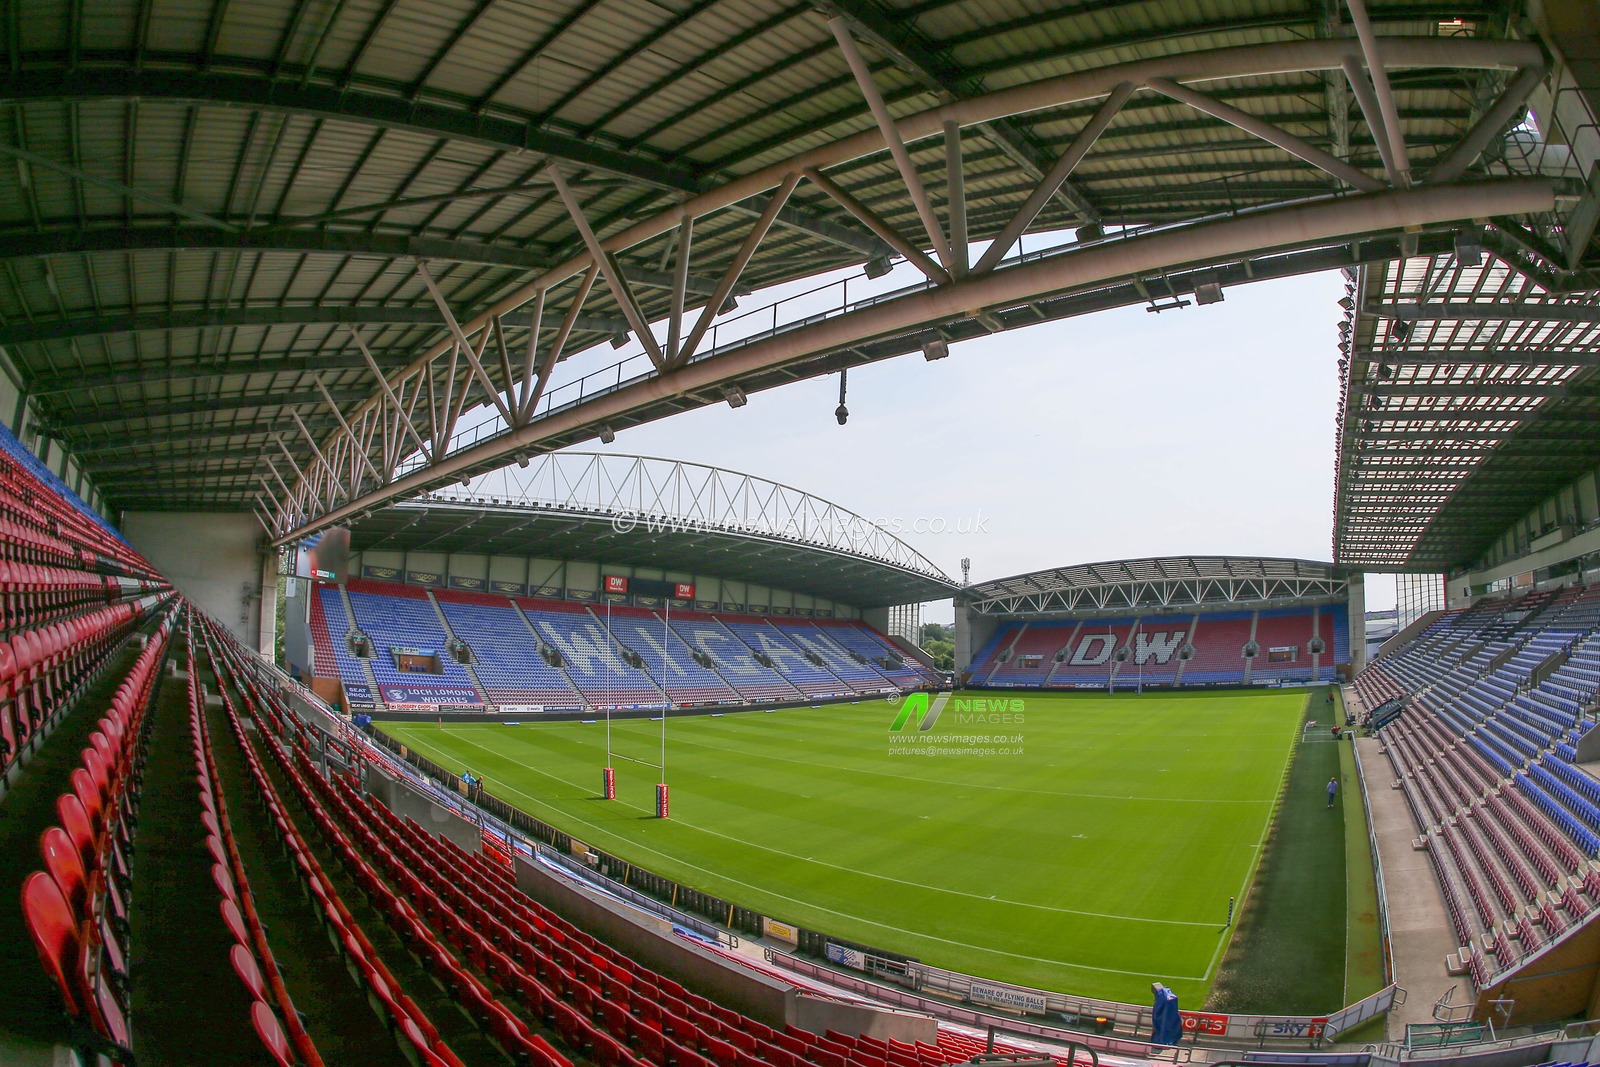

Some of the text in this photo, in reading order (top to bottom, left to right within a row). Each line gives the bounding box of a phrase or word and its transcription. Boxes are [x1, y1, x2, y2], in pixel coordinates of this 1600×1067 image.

[610, 577, 623, 586] DW
[679, 584, 690, 592] DW
[539, 621, 867, 677] WIGAN
[1068, 631, 1186, 666] DW
[408, 688, 475, 697] LOCH LOMOND
[972, 986, 995, 997] BEWARE
[1004, 992, 1025, 1002] FLYING
[1025, 997, 1044, 1006] BALLS
[1273, 1019, 1307, 1037] sky
